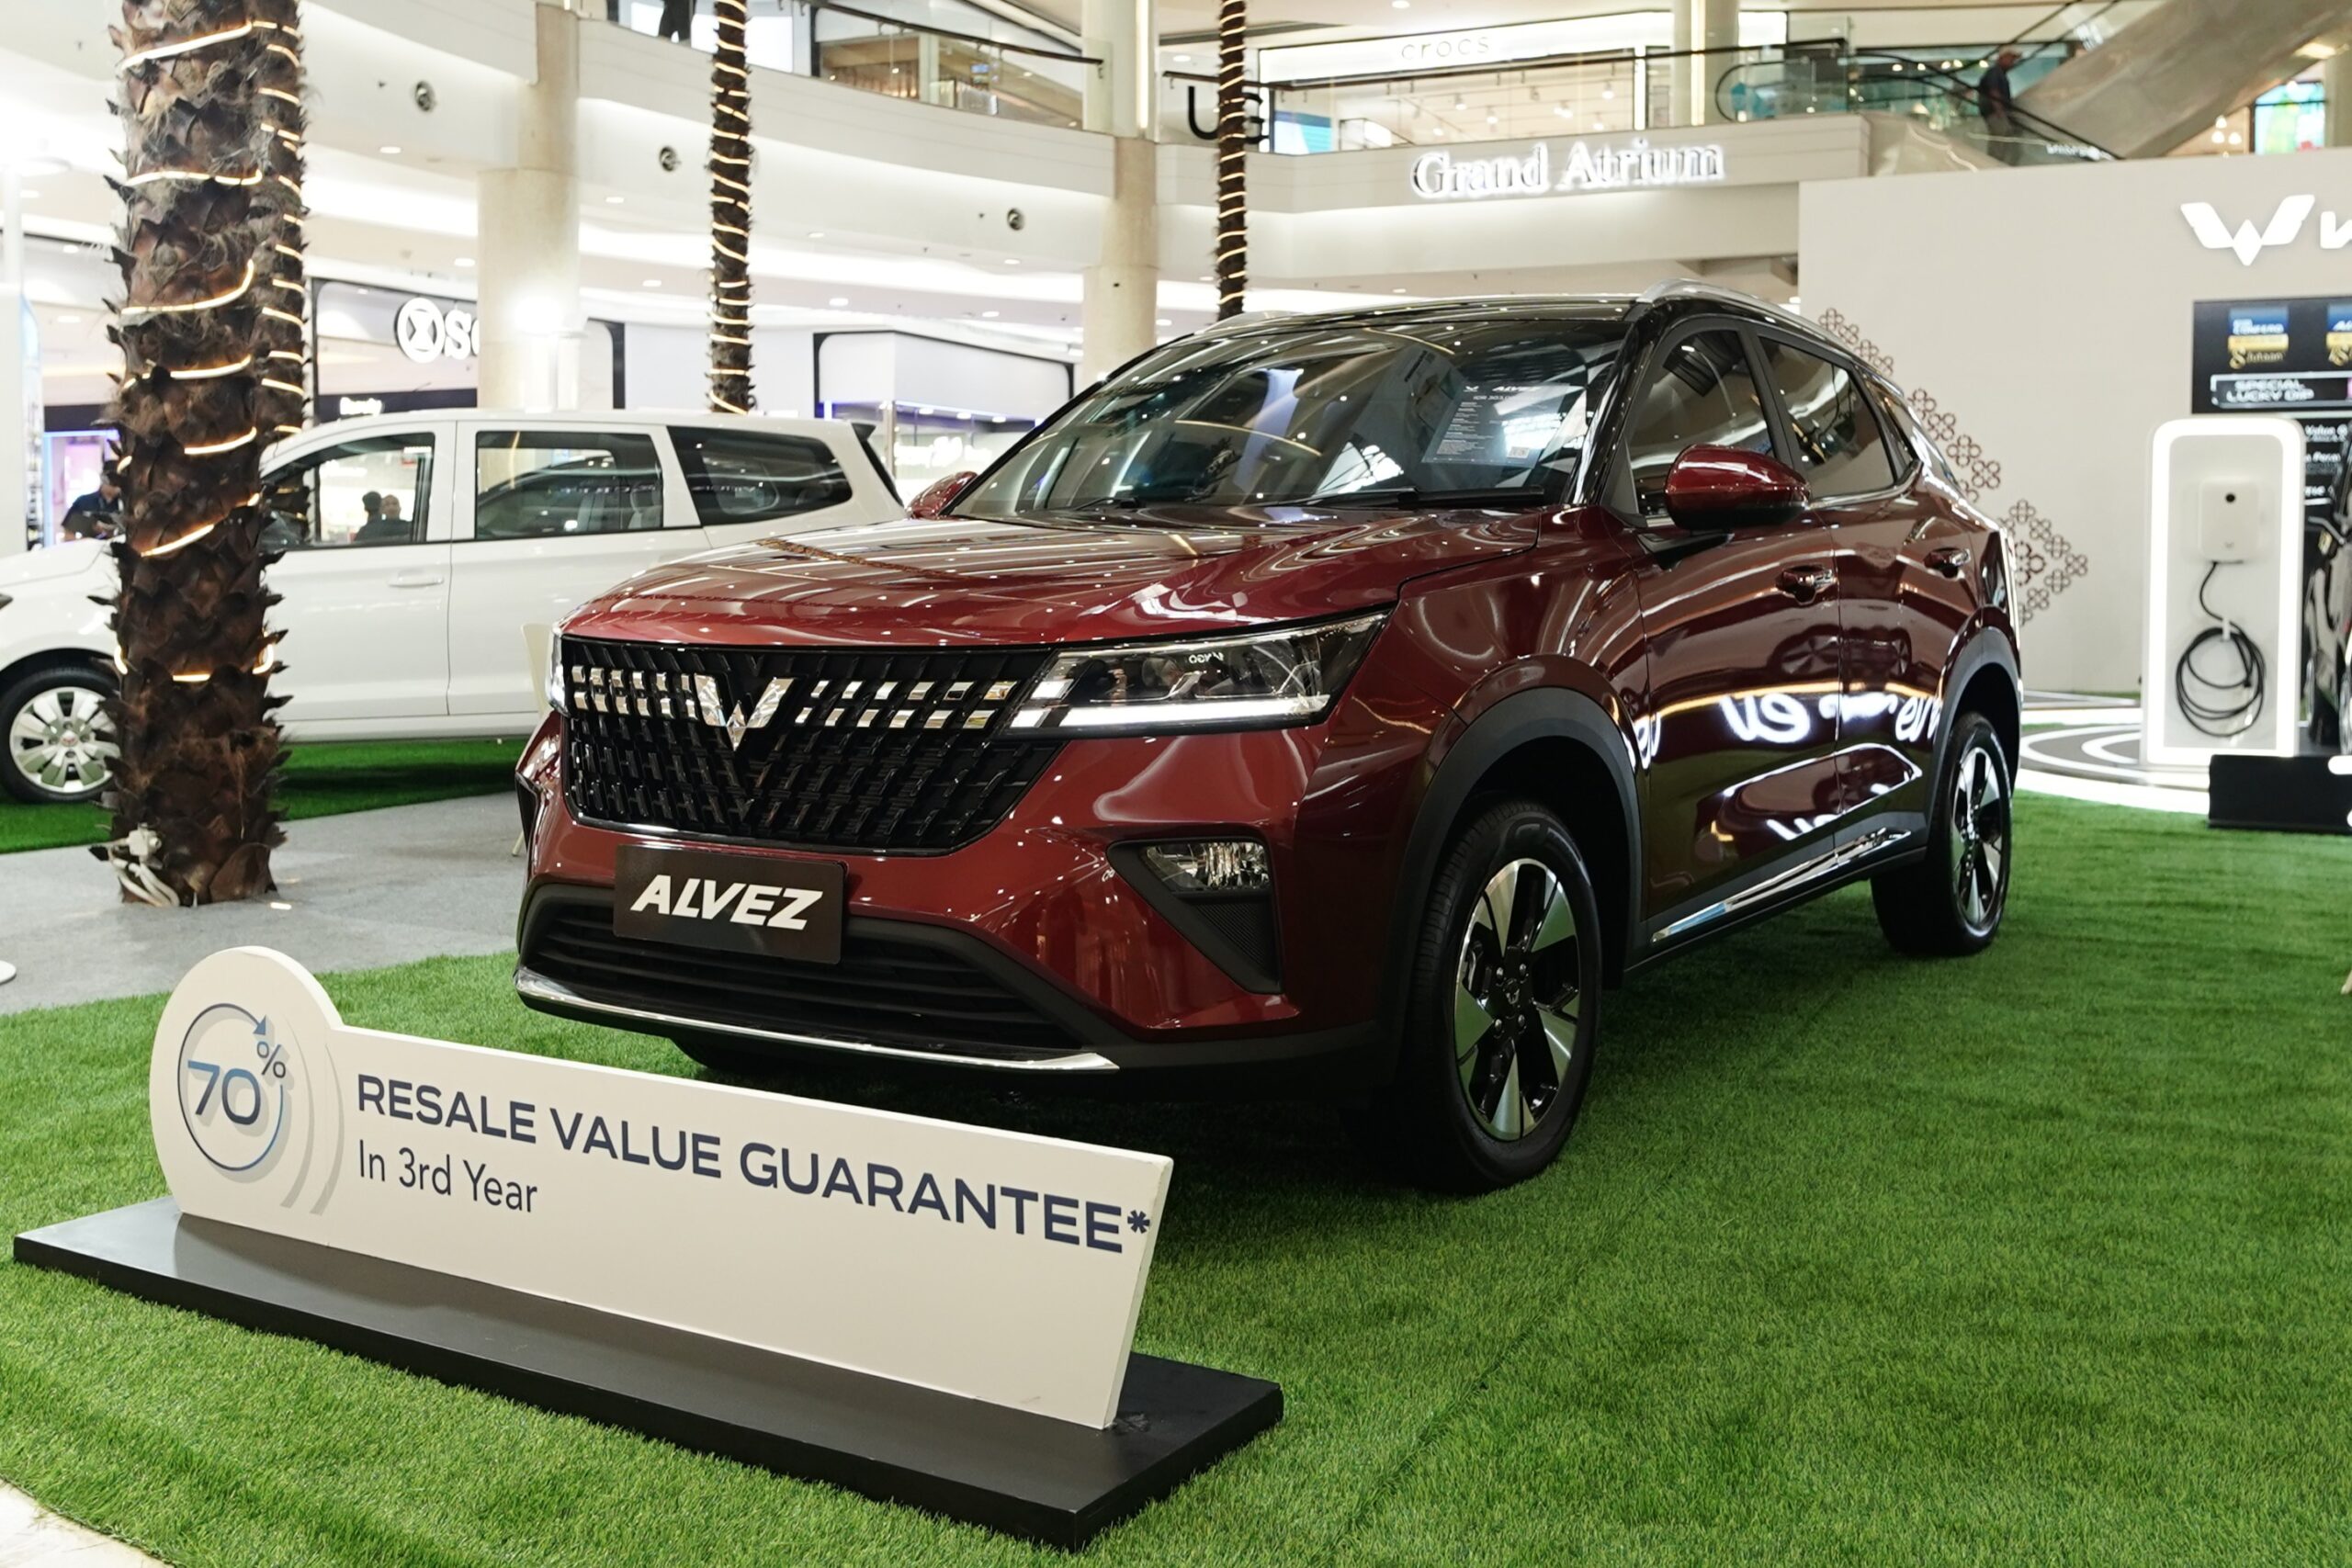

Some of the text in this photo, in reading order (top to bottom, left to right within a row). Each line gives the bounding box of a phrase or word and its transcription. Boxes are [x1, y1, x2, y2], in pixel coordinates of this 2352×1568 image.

[1401, 37, 1490, 61] crocs
[1412, 138, 1724, 197] Grand Atrium
[2226, 389, 2314, 402] LUCKY DIP
[2234, 379, 2304, 391] SPECIAL
[629, 874, 824, 931] ALVEZ
[187, 1041, 287, 1126] 70%
[357, 1073, 537, 1144] RESALE
[549, 1107, 721, 1179] VALUE
[359, 1139, 538, 1213] In 3rd Year
